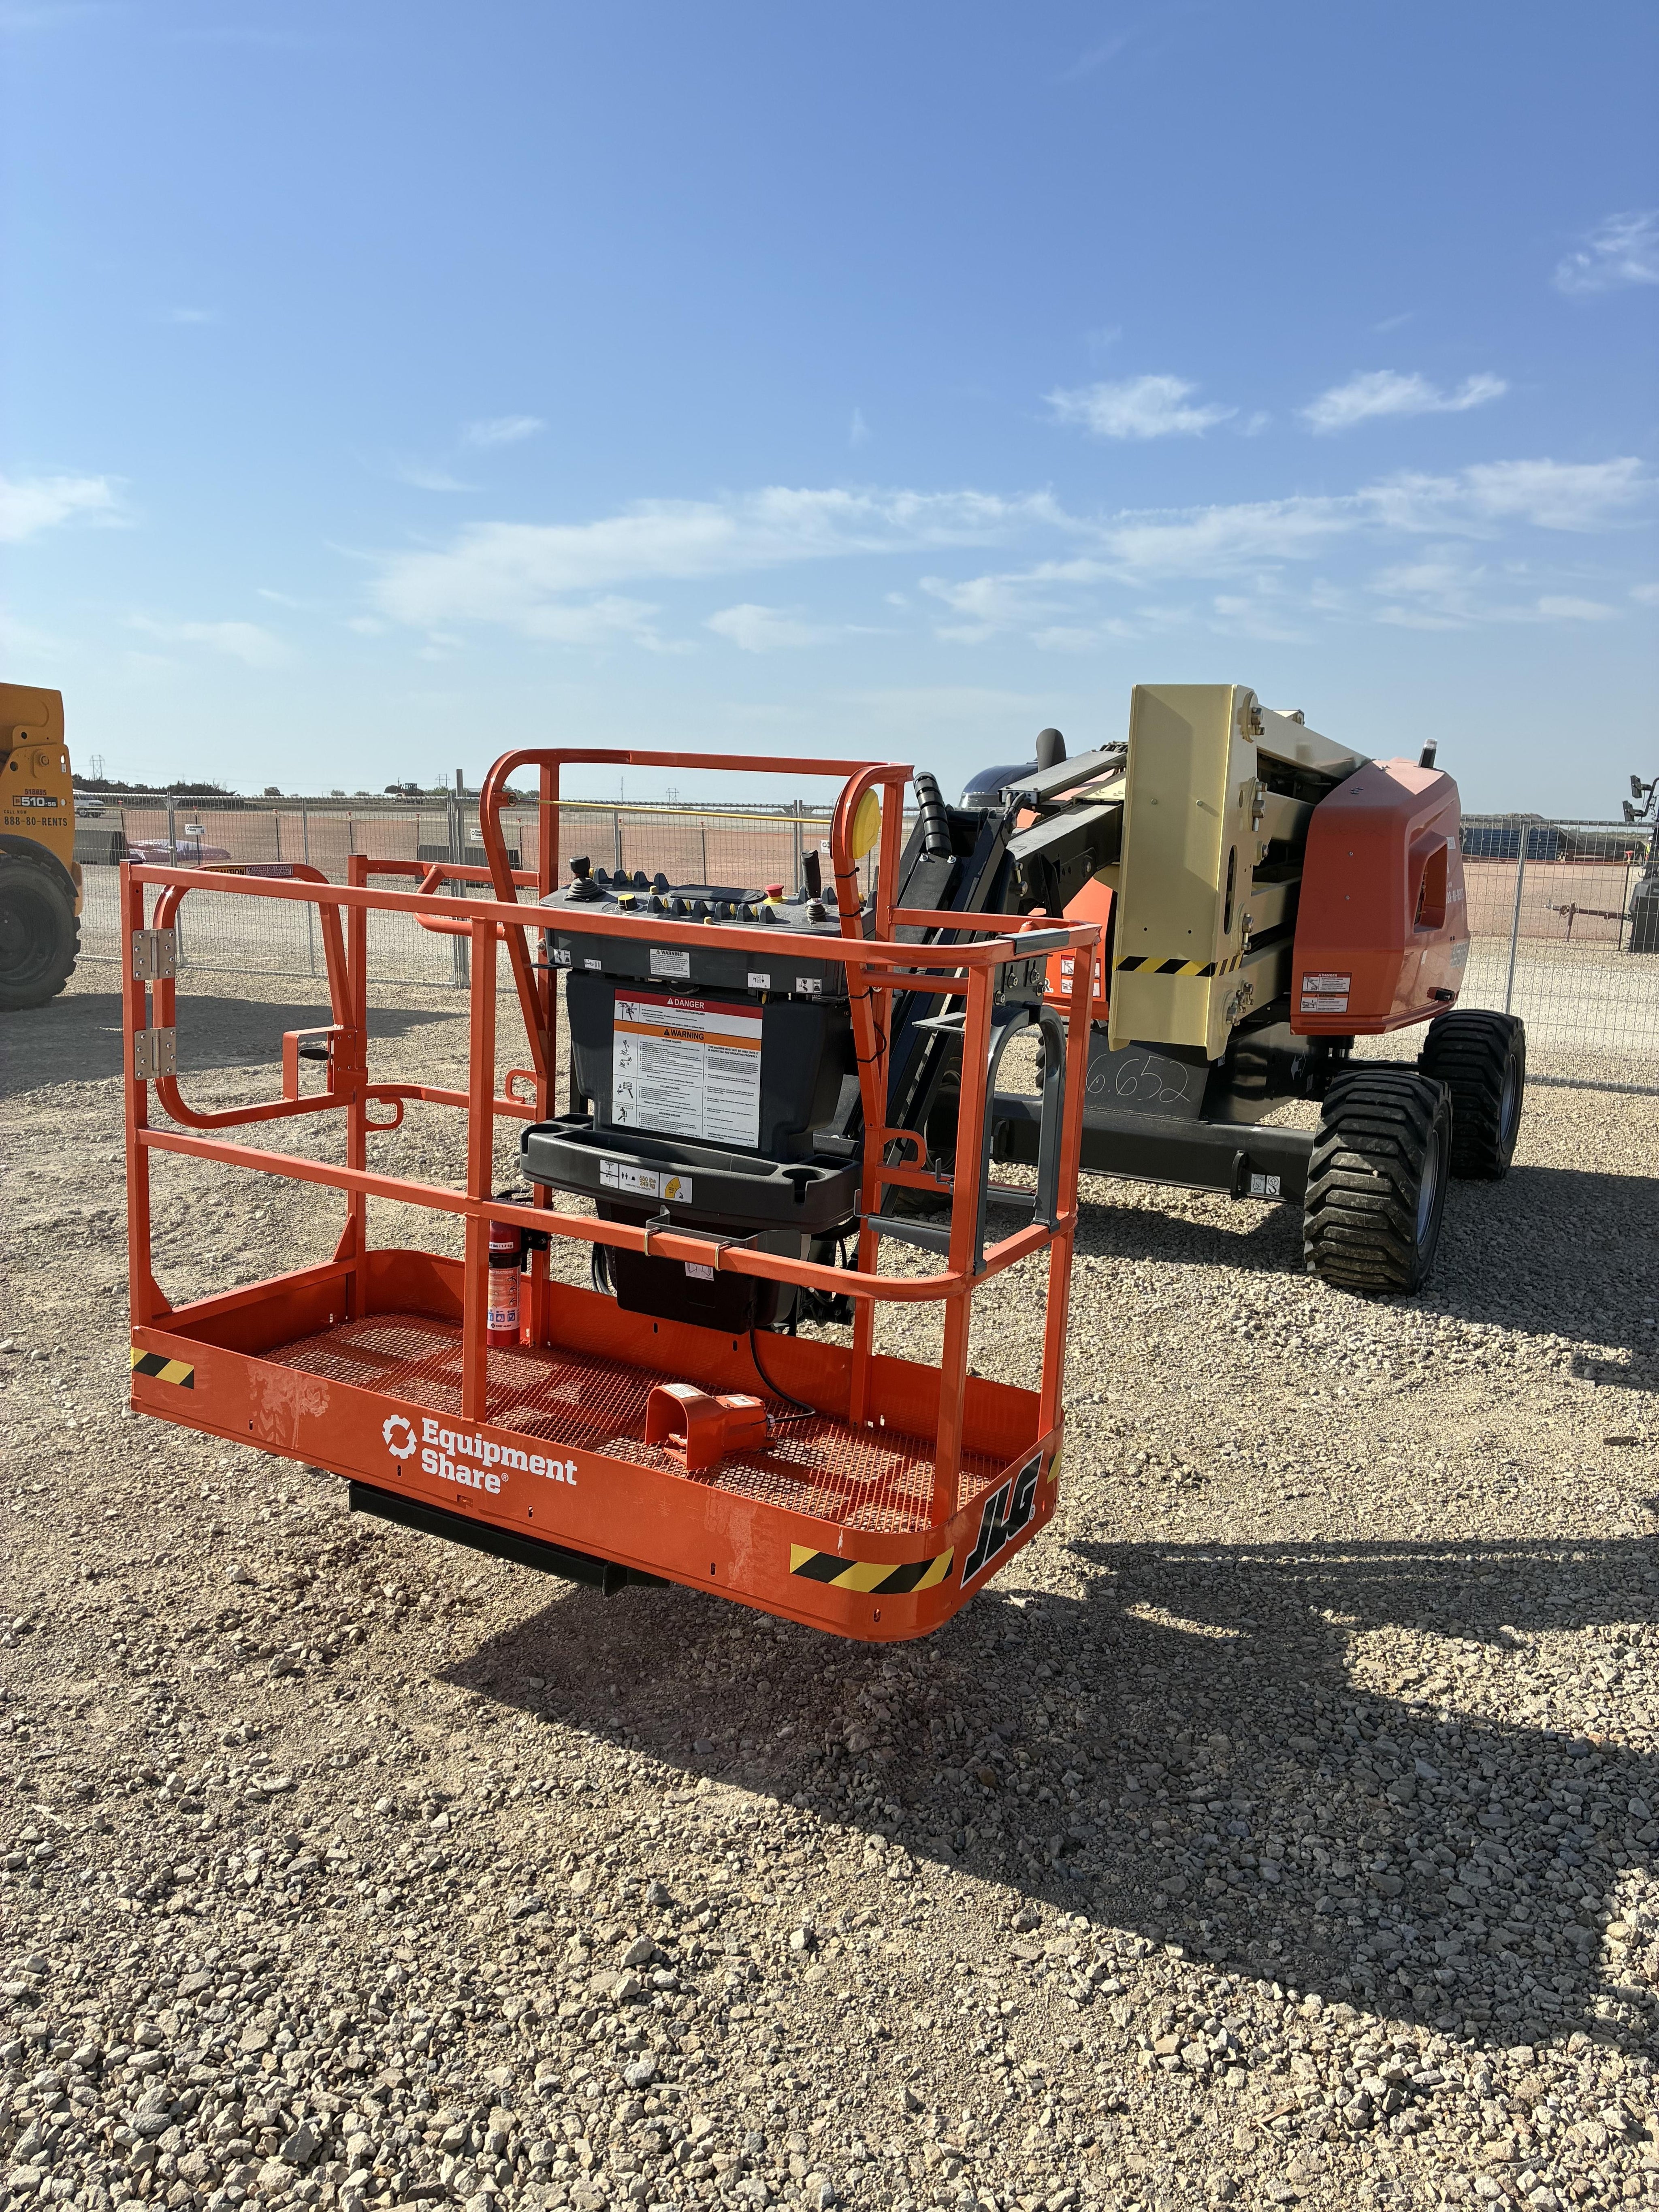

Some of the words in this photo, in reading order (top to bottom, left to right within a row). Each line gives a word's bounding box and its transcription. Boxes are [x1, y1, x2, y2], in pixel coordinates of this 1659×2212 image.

[4, 816, 67, 826] 888-80-RENTS
[674, 998, 704, 1009] DANGER
[671, 1029, 704, 1040] WARNING
[422, 1417, 578, 1486] Equipment
